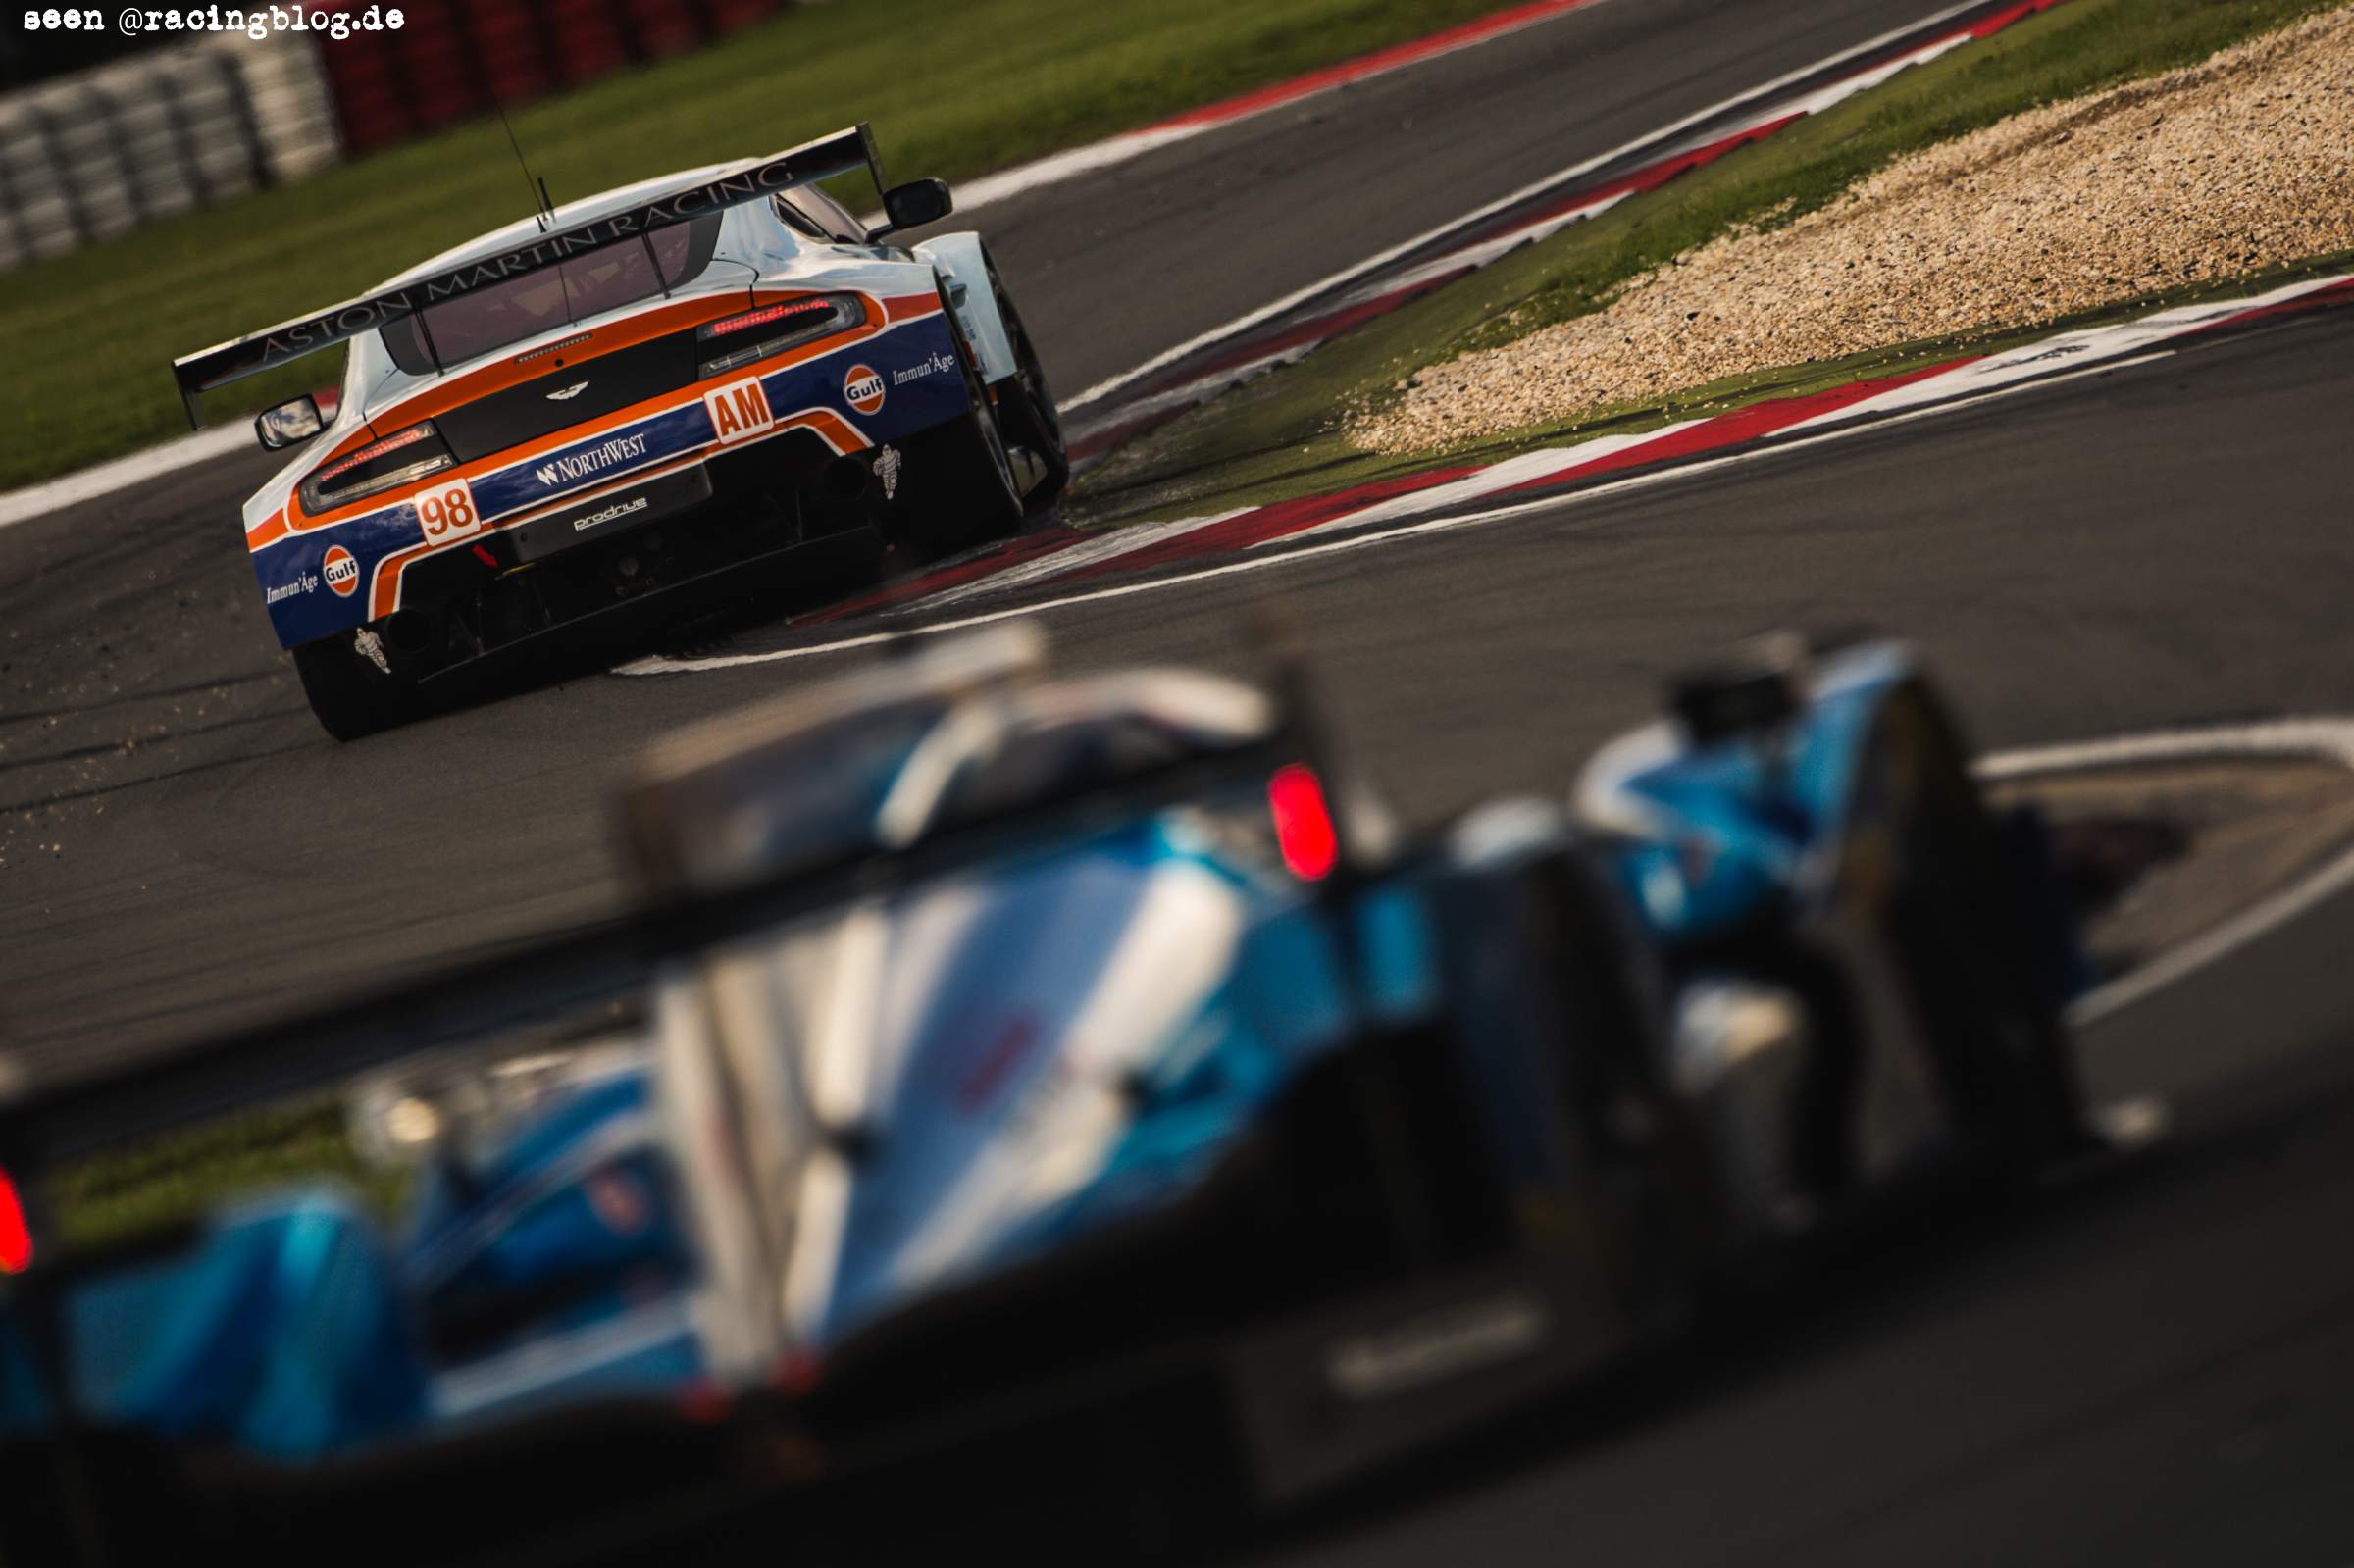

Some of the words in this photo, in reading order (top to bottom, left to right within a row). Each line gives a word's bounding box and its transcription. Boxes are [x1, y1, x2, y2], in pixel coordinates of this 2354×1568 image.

[263, 291, 412, 362] ASTON
[428, 227, 598, 302] MARTIN
[608, 161, 793, 237] RACING
[714, 383, 769, 437] AM
[846, 378, 883, 401] Gulf
[421, 488, 473, 536] 98
[573, 497, 647, 531] prodrive
[325, 560, 356, 582] Gulf
